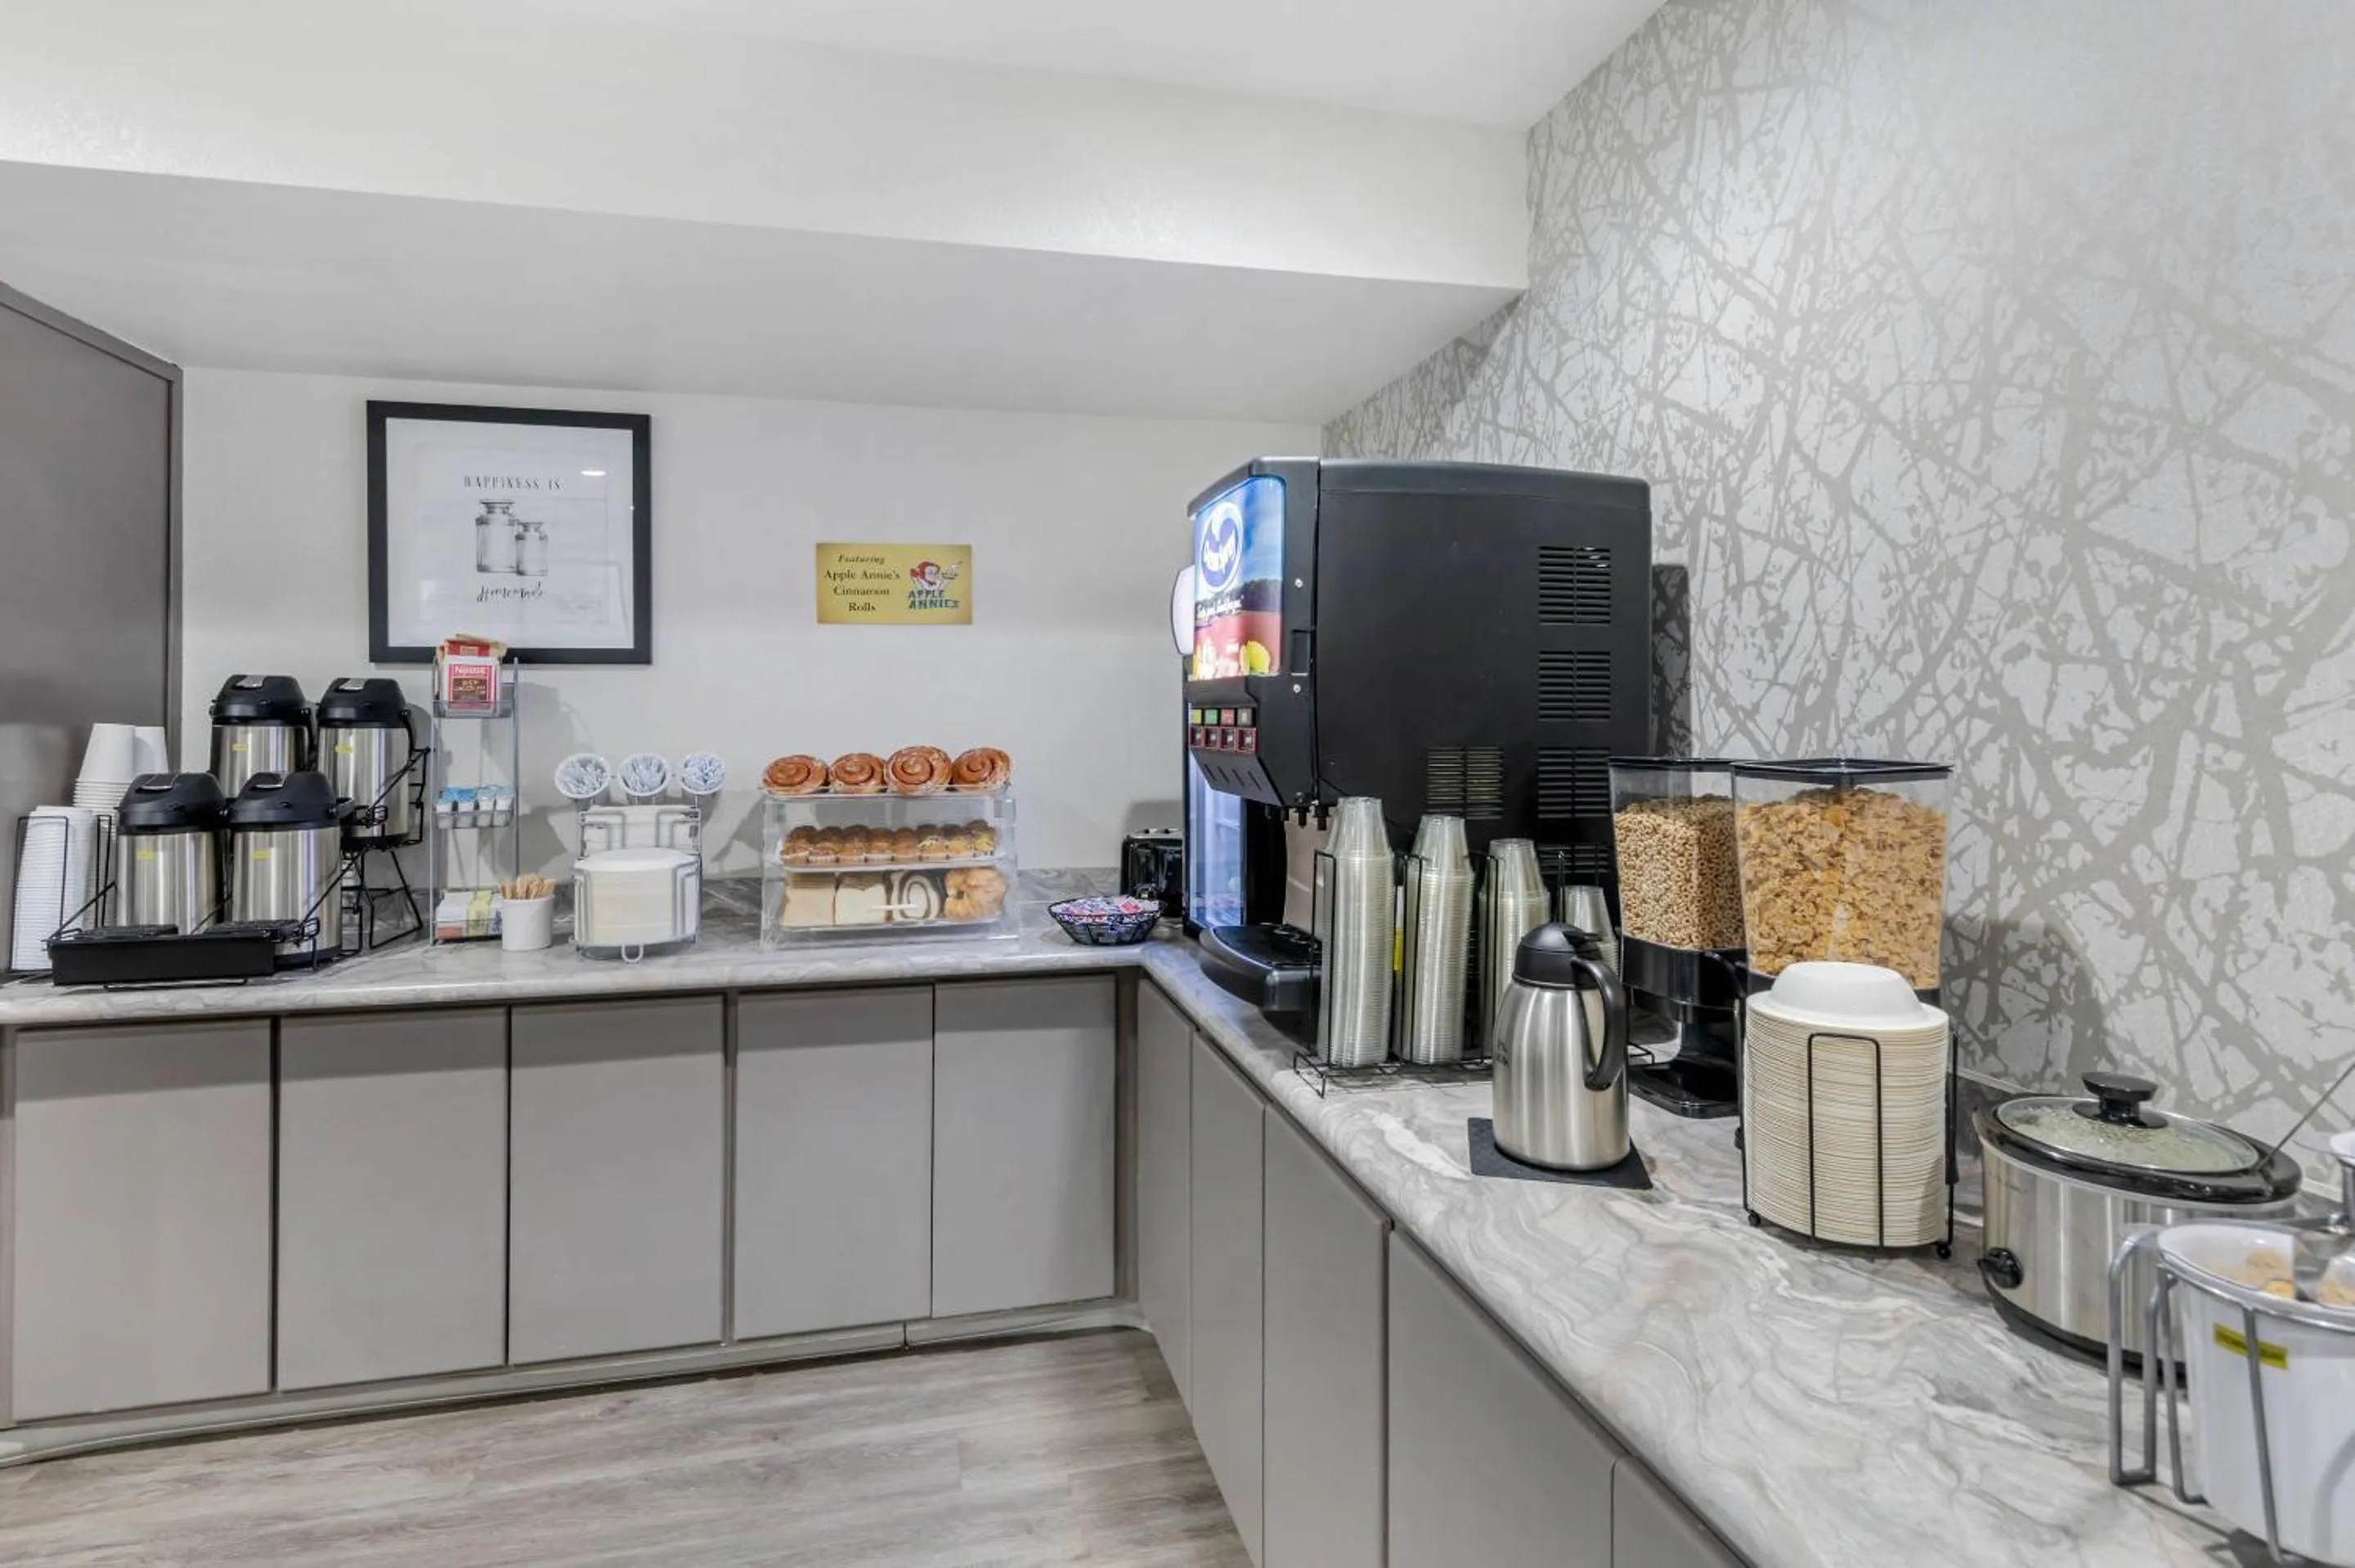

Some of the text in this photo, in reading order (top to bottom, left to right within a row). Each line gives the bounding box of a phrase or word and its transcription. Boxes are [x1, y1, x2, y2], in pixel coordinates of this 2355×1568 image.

[464, 476, 541, 489] HAPPINESS
[837, 554, 885, 565] Featuring
[824, 569, 901, 582] Apple Annie's
[833, 586, 890, 596] Cinnamon
[908, 589, 944, 599] APPLE
[849, 602, 877, 612] Rolls
